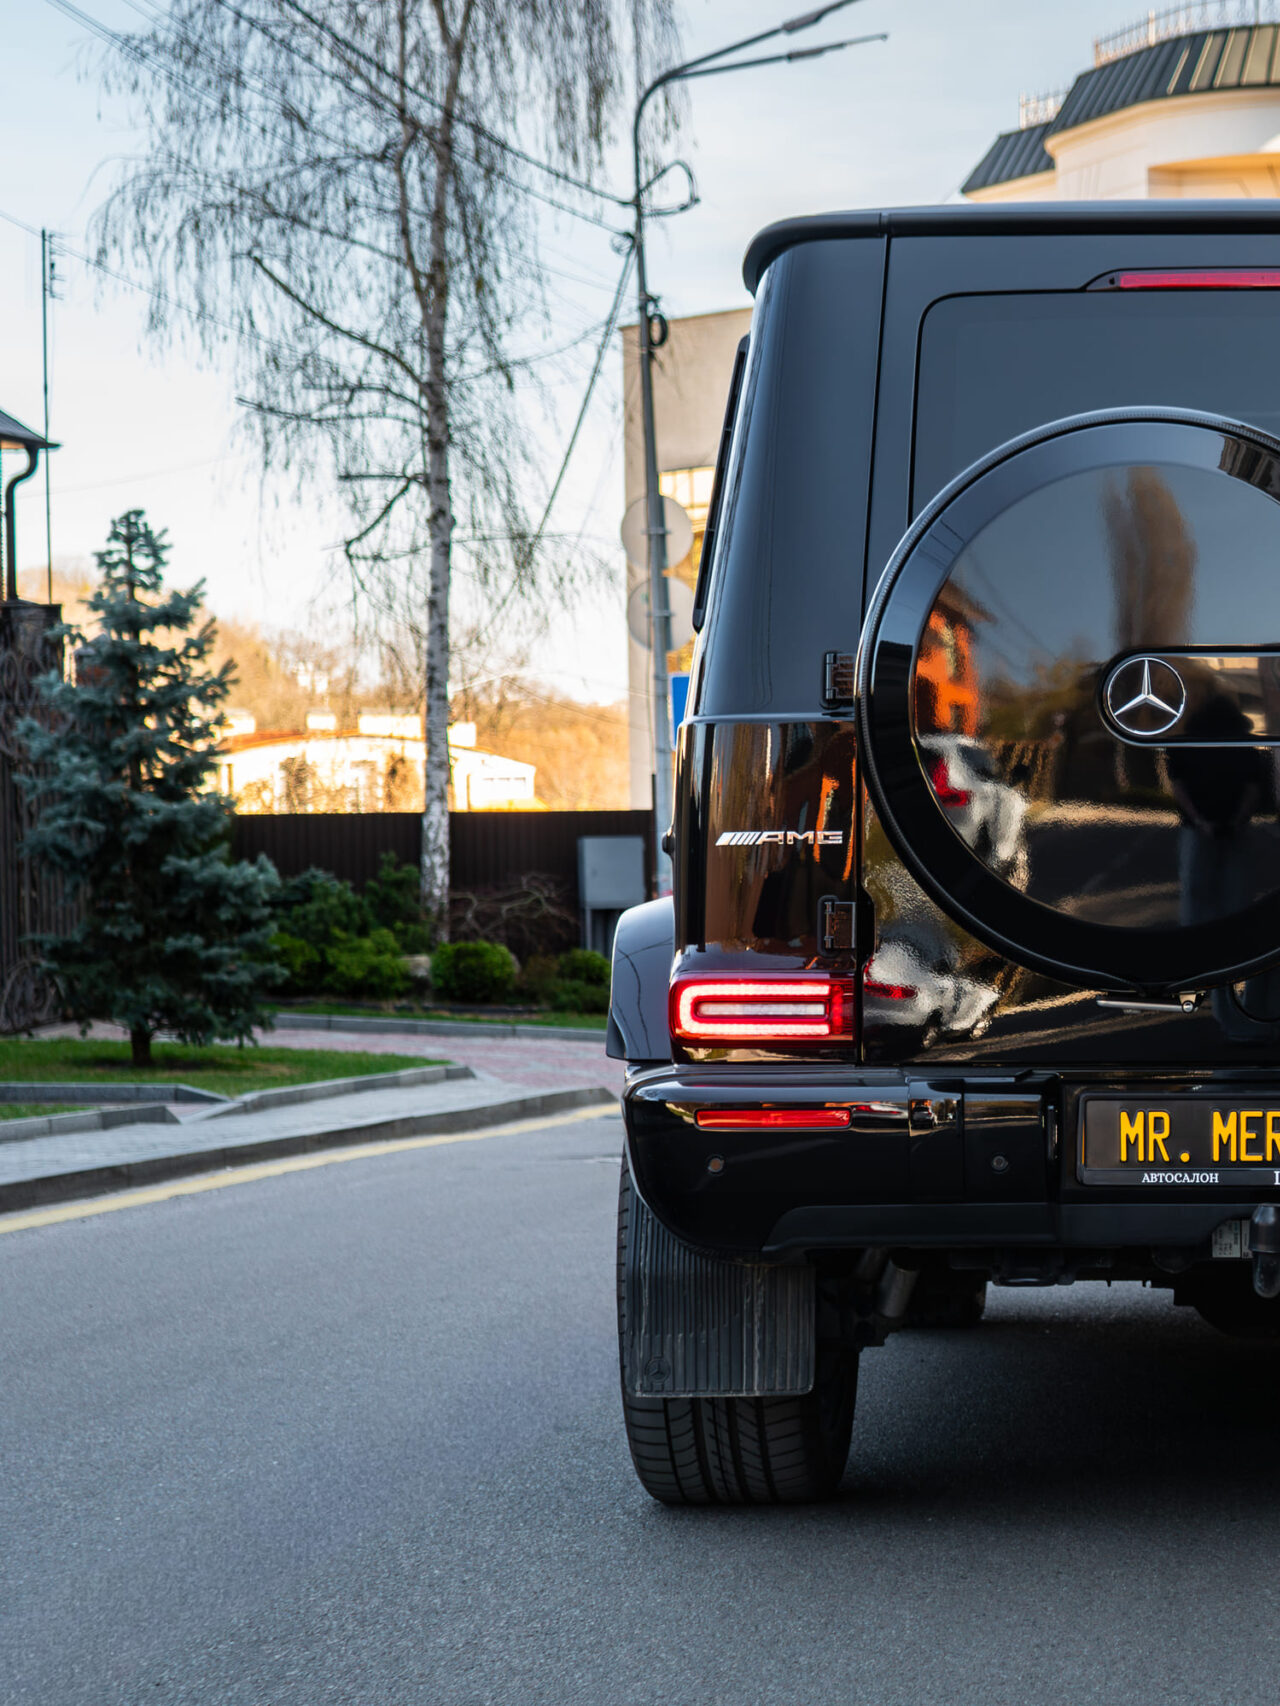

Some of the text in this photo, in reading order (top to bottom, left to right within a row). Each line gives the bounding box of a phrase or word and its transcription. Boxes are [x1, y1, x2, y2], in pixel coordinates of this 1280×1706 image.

[753, 831, 843, 845] AMG
[1119, 1110, 1190, 1163] MR.
[1141, 1172, 1220, 1184] АВТОСАЛОН
